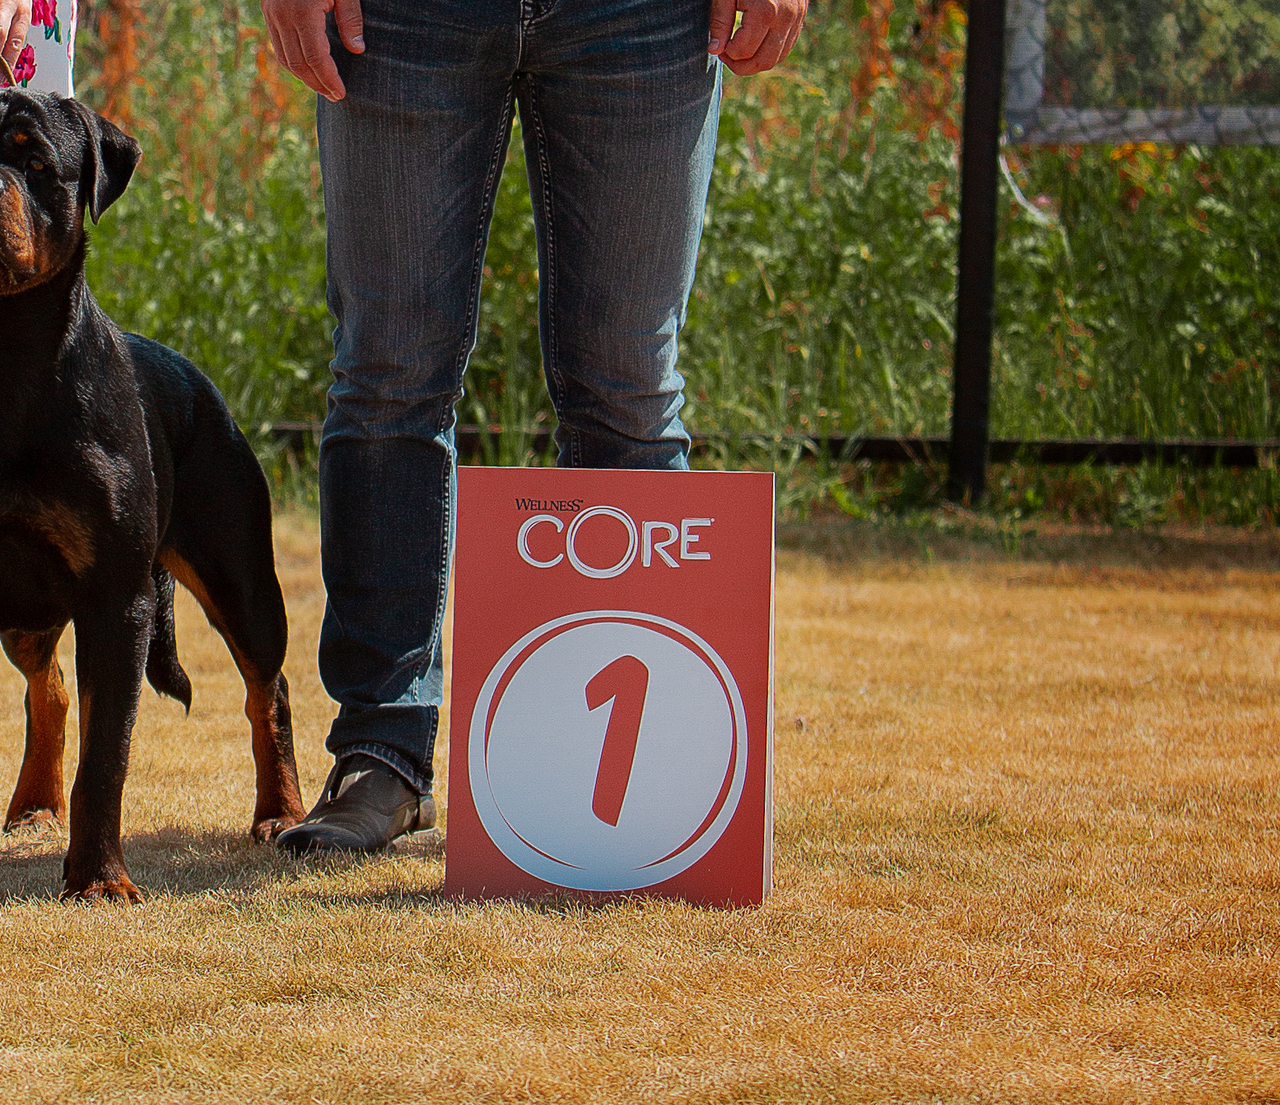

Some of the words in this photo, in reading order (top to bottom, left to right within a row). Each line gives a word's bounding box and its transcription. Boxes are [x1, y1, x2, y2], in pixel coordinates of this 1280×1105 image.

[515, 498, 581, 511] WELLNESS
[517, 505, 711, 578] CORE
[584, 653, 650, 828] 1
